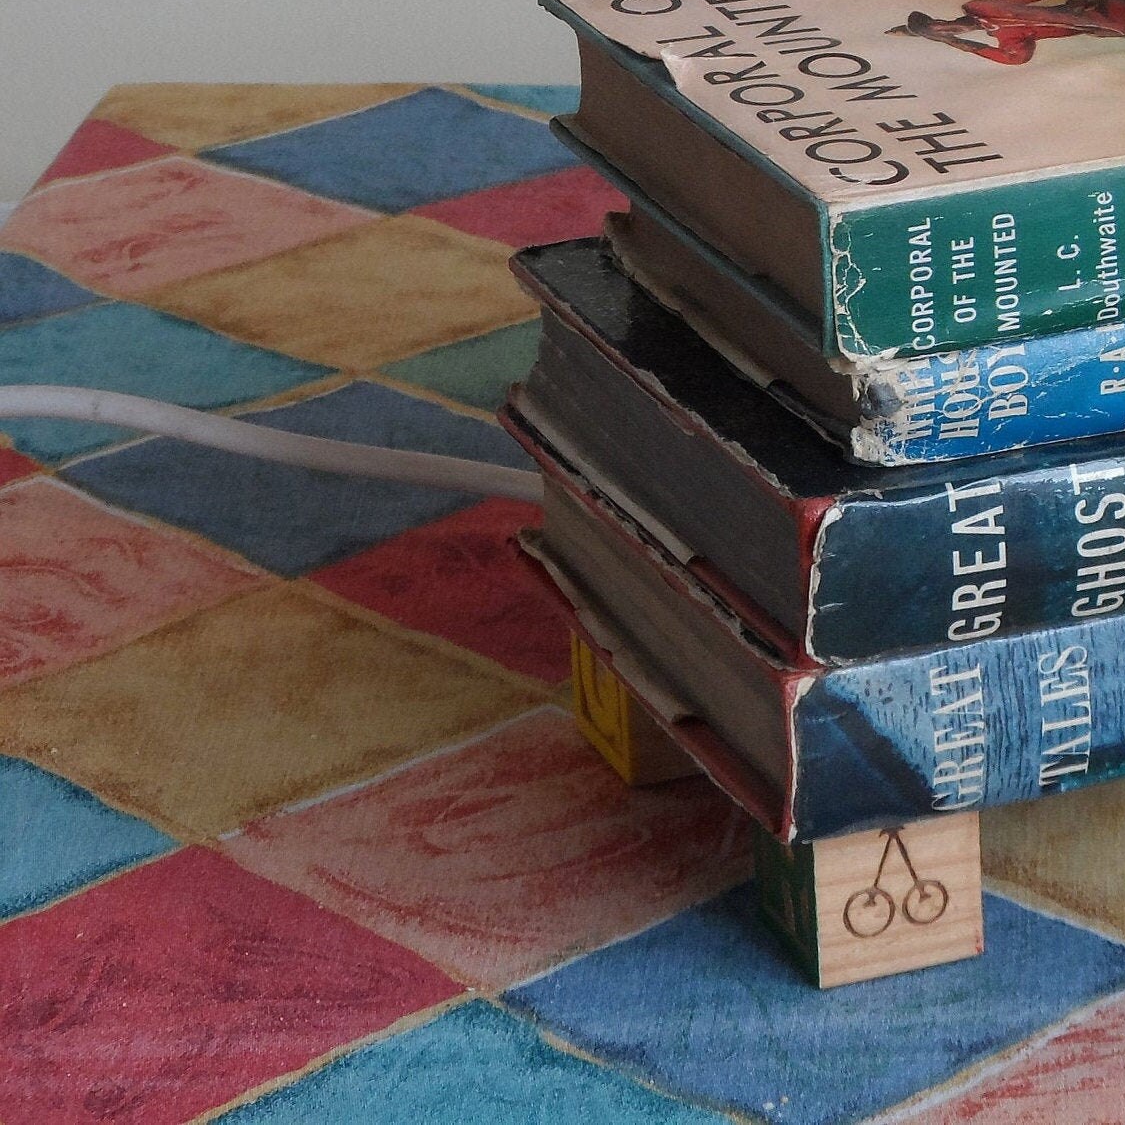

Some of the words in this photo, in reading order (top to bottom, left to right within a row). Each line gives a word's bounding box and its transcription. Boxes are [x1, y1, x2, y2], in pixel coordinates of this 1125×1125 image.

[657, 25, 909, 186] CORPORAL
[876, 112, 1003, 174] THE
[908, 217, 935, 351] CORPORAL
[951, 237, 975, 282] THE
[954, 295, 977, 323] OF
[992, 213, 1020, 331] MOUNTED
[1093, 191, 1119, 321] Douthwaite
[987, 344, 1028, 420] BOY
[947, 478, 1006, 641] GREAT
[930, 662, 985, 812] GREAT
[1037, 645, 1092, 786] TALES
